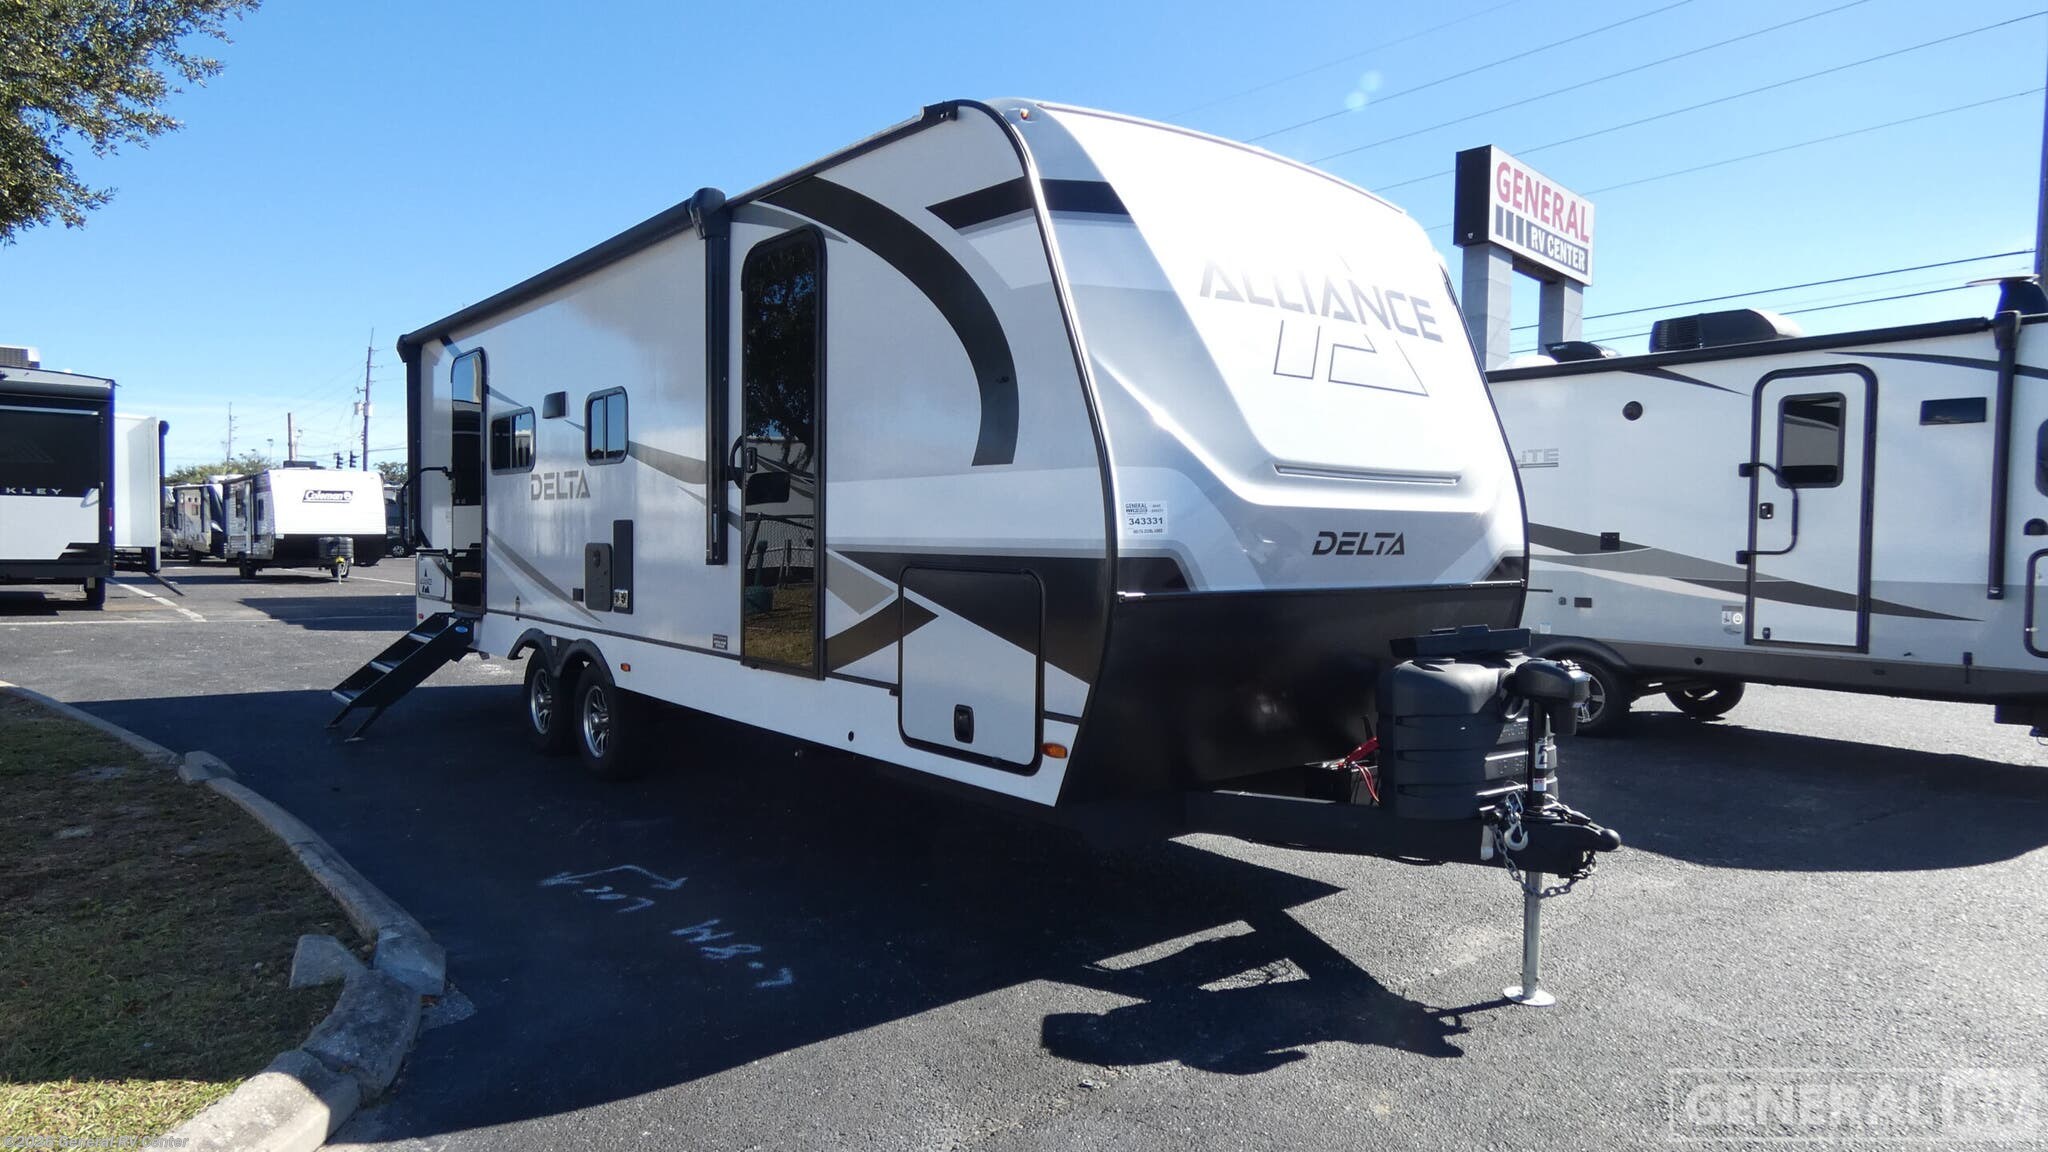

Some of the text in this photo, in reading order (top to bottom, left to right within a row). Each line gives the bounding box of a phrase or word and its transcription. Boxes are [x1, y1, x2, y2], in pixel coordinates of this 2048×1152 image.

[1496, 161, 1590, 244] GENERAL
[1530, 225, 1587, 274] RV CENTER
[1199, 259, 1444, 343] ALLIANCE
[305, 490, 343, 501] Coleman
[530, 469, 591, 501] DELTA
[1128, 517, 1164, 526] 343331
[1312, 531, 1405, 555] DELTA
